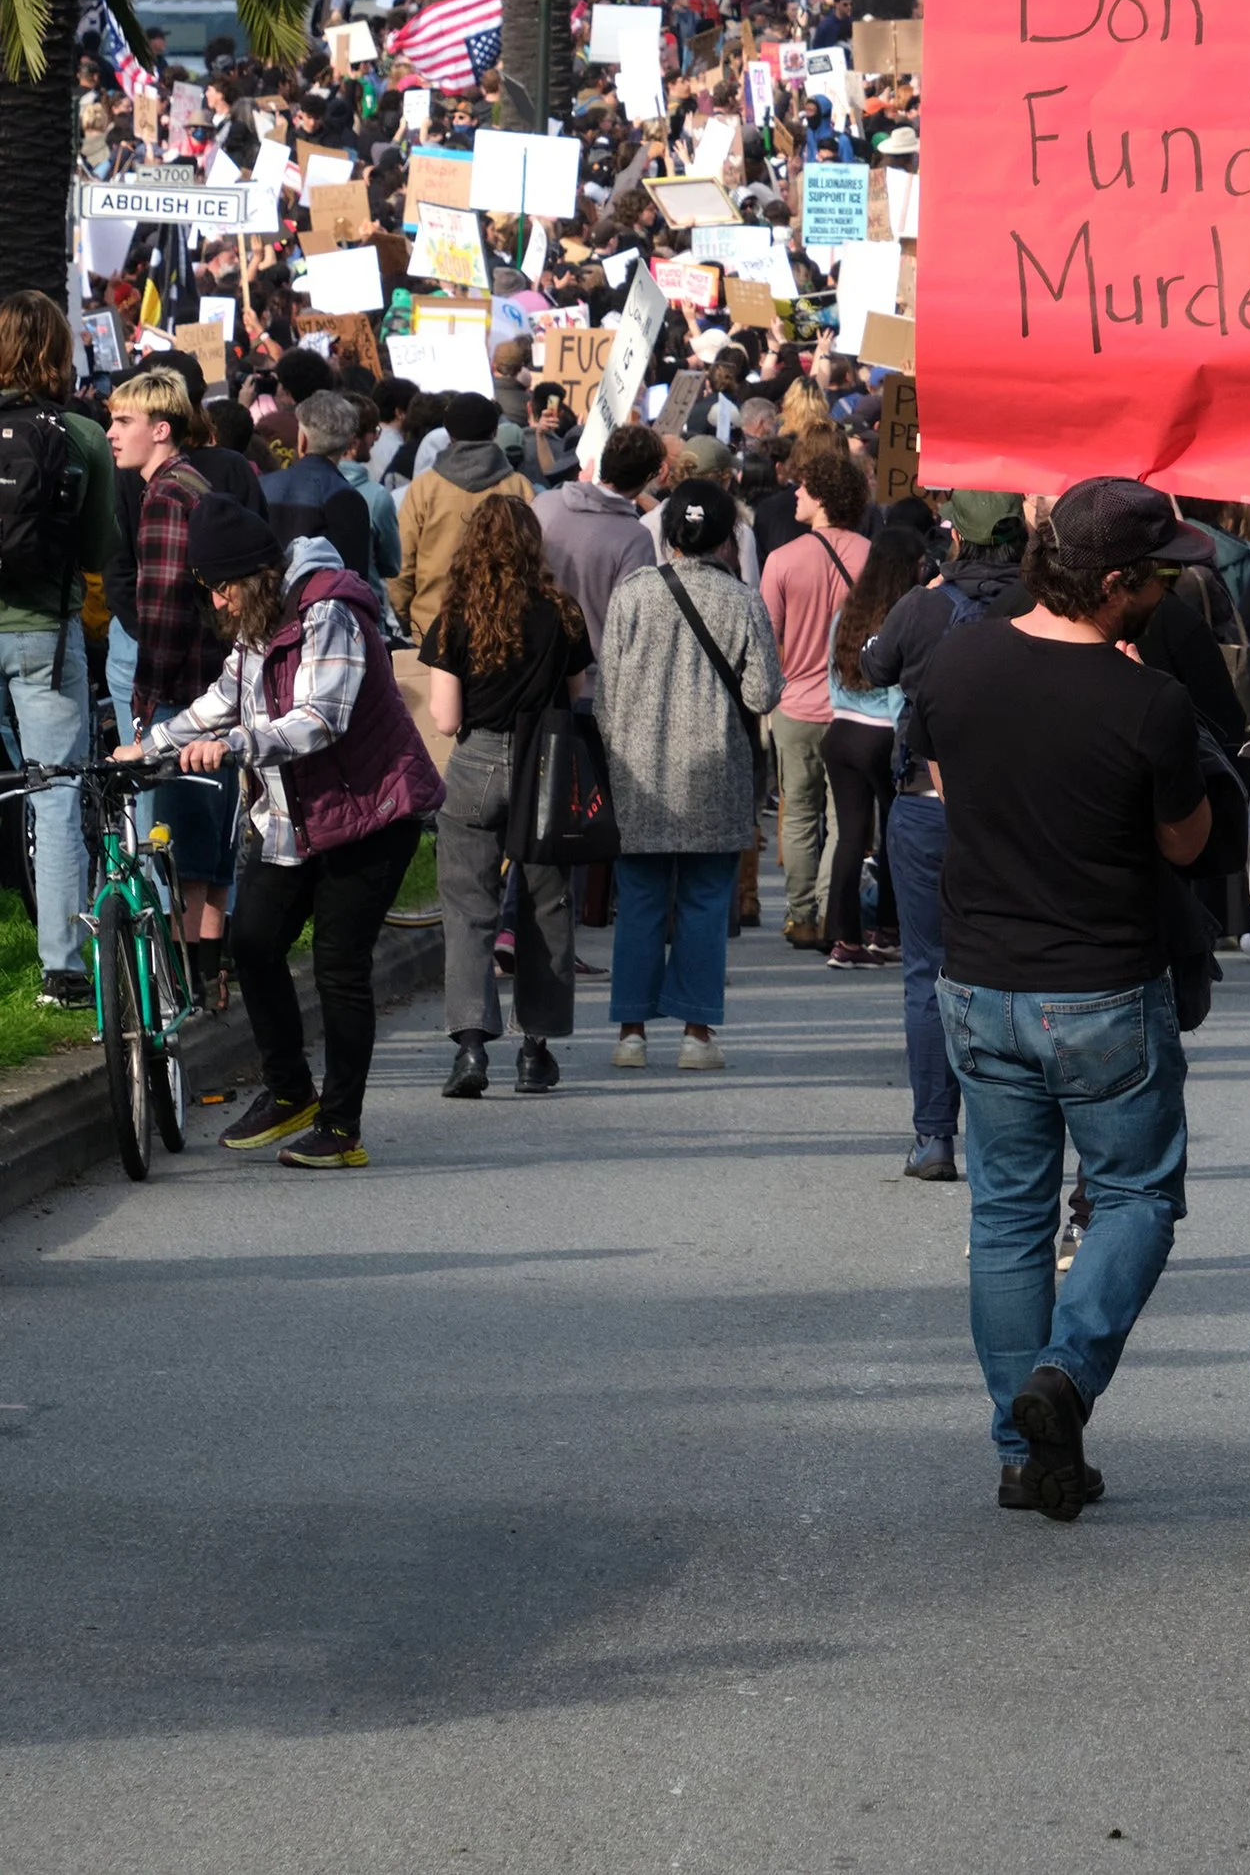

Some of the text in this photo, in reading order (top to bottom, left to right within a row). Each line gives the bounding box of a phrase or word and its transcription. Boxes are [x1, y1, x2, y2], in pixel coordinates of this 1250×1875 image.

[153, 168, 190, 182] 3700
[807, 177, 863, 189] BILLIONAIRES
[808, 191, 861, 203] SUPPORT ICE
[101, 193, 229, 217] ABOLISH ICE
[807, 207, 836, 215] WORKERS
[838, 207, 853, 215] NEED
[814, 217, 854, 225] INDEPENDENT
[809, 226, 859, 235] SOCIALIST PARTY
